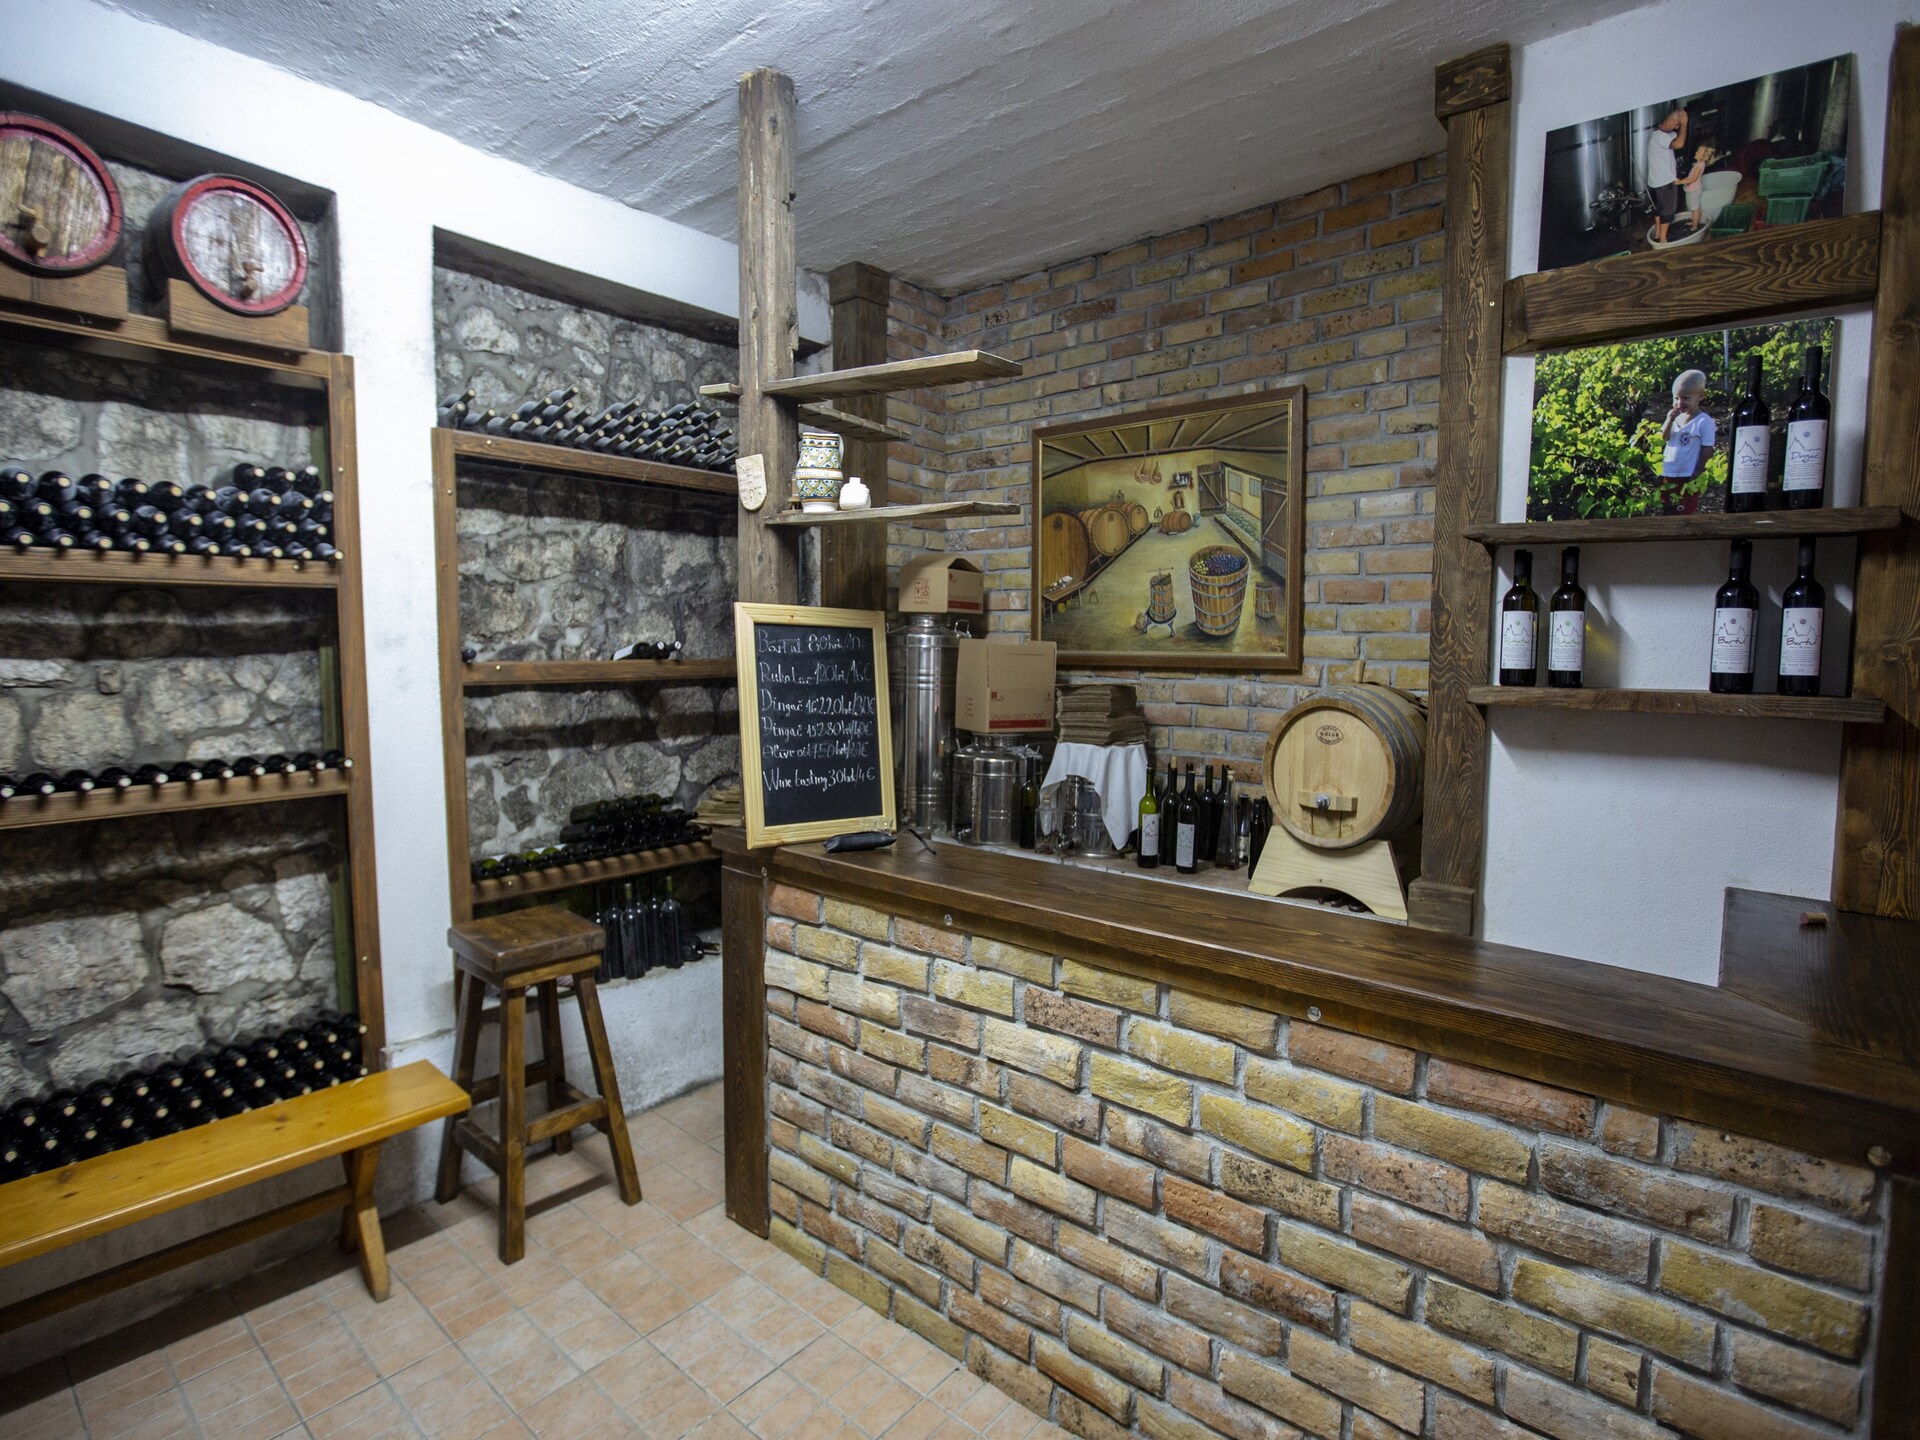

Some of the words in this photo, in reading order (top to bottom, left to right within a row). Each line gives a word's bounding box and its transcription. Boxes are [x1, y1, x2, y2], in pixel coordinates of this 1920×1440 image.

[1717, 635, 1747, 645] Bartul
[1786, 636, 1818, 646] Bartul
[760, 689, 803, 717] Dingač
[762, 766, 792, 791] Wine
[795, 769, 828, 792] tasting
